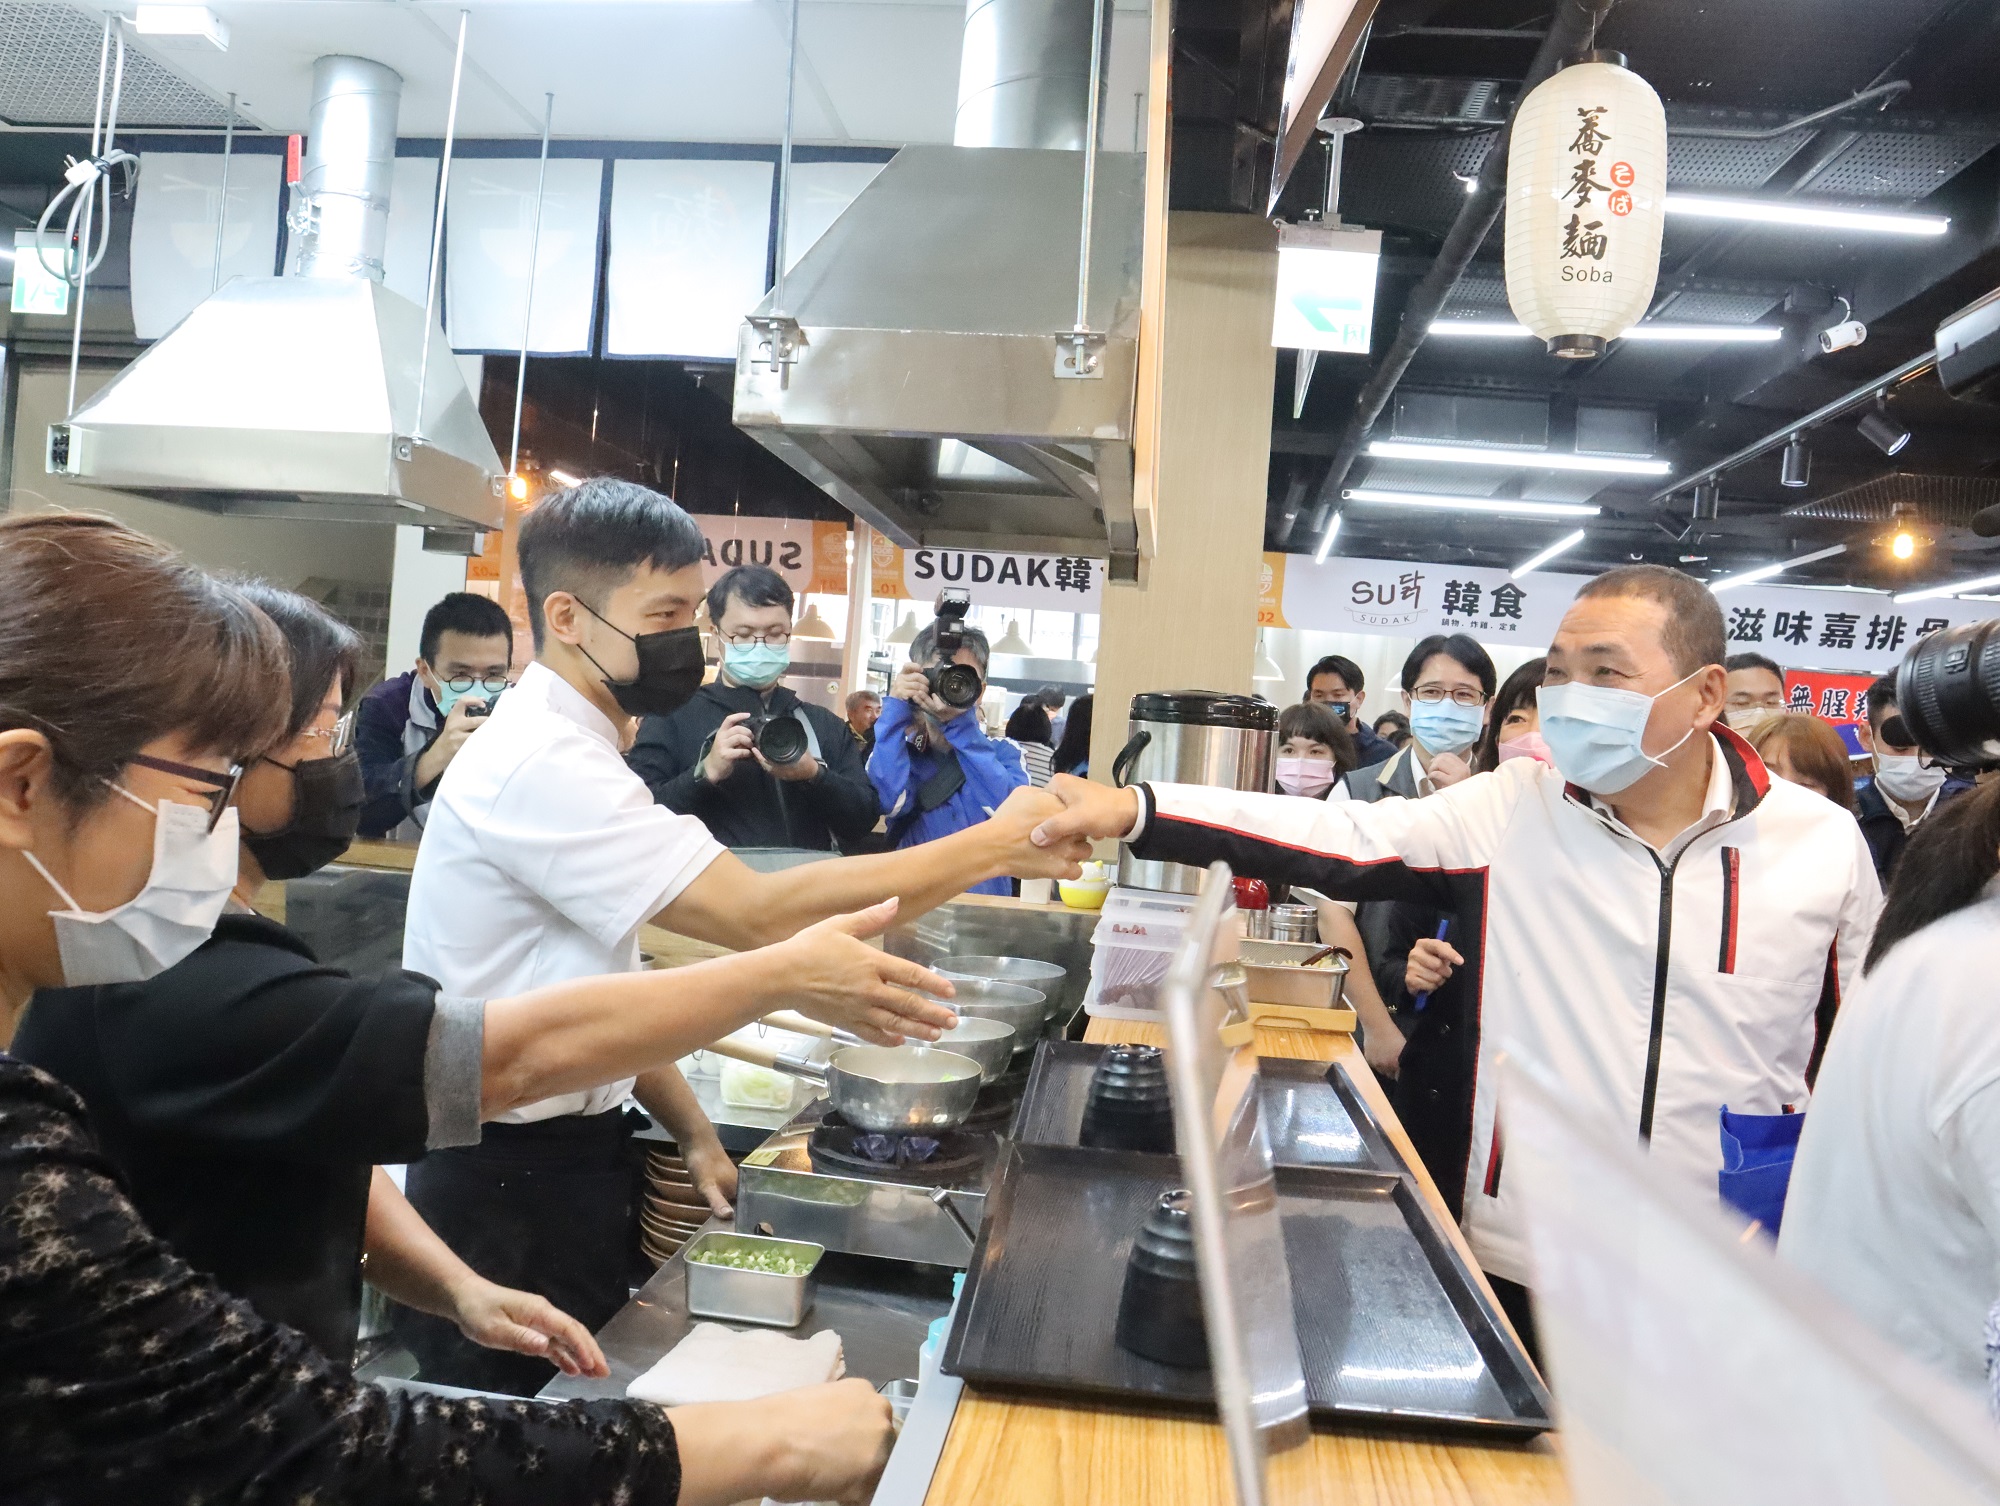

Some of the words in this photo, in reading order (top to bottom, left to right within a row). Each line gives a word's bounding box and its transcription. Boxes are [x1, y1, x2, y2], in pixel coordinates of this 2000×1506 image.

[1609, 163, 1634, 215] そば
[1561, 266, 1613, 283] Soba
[1442, 580, 1527, 619] 韓食
[1360, 614, 1410, 625] SUDAK
